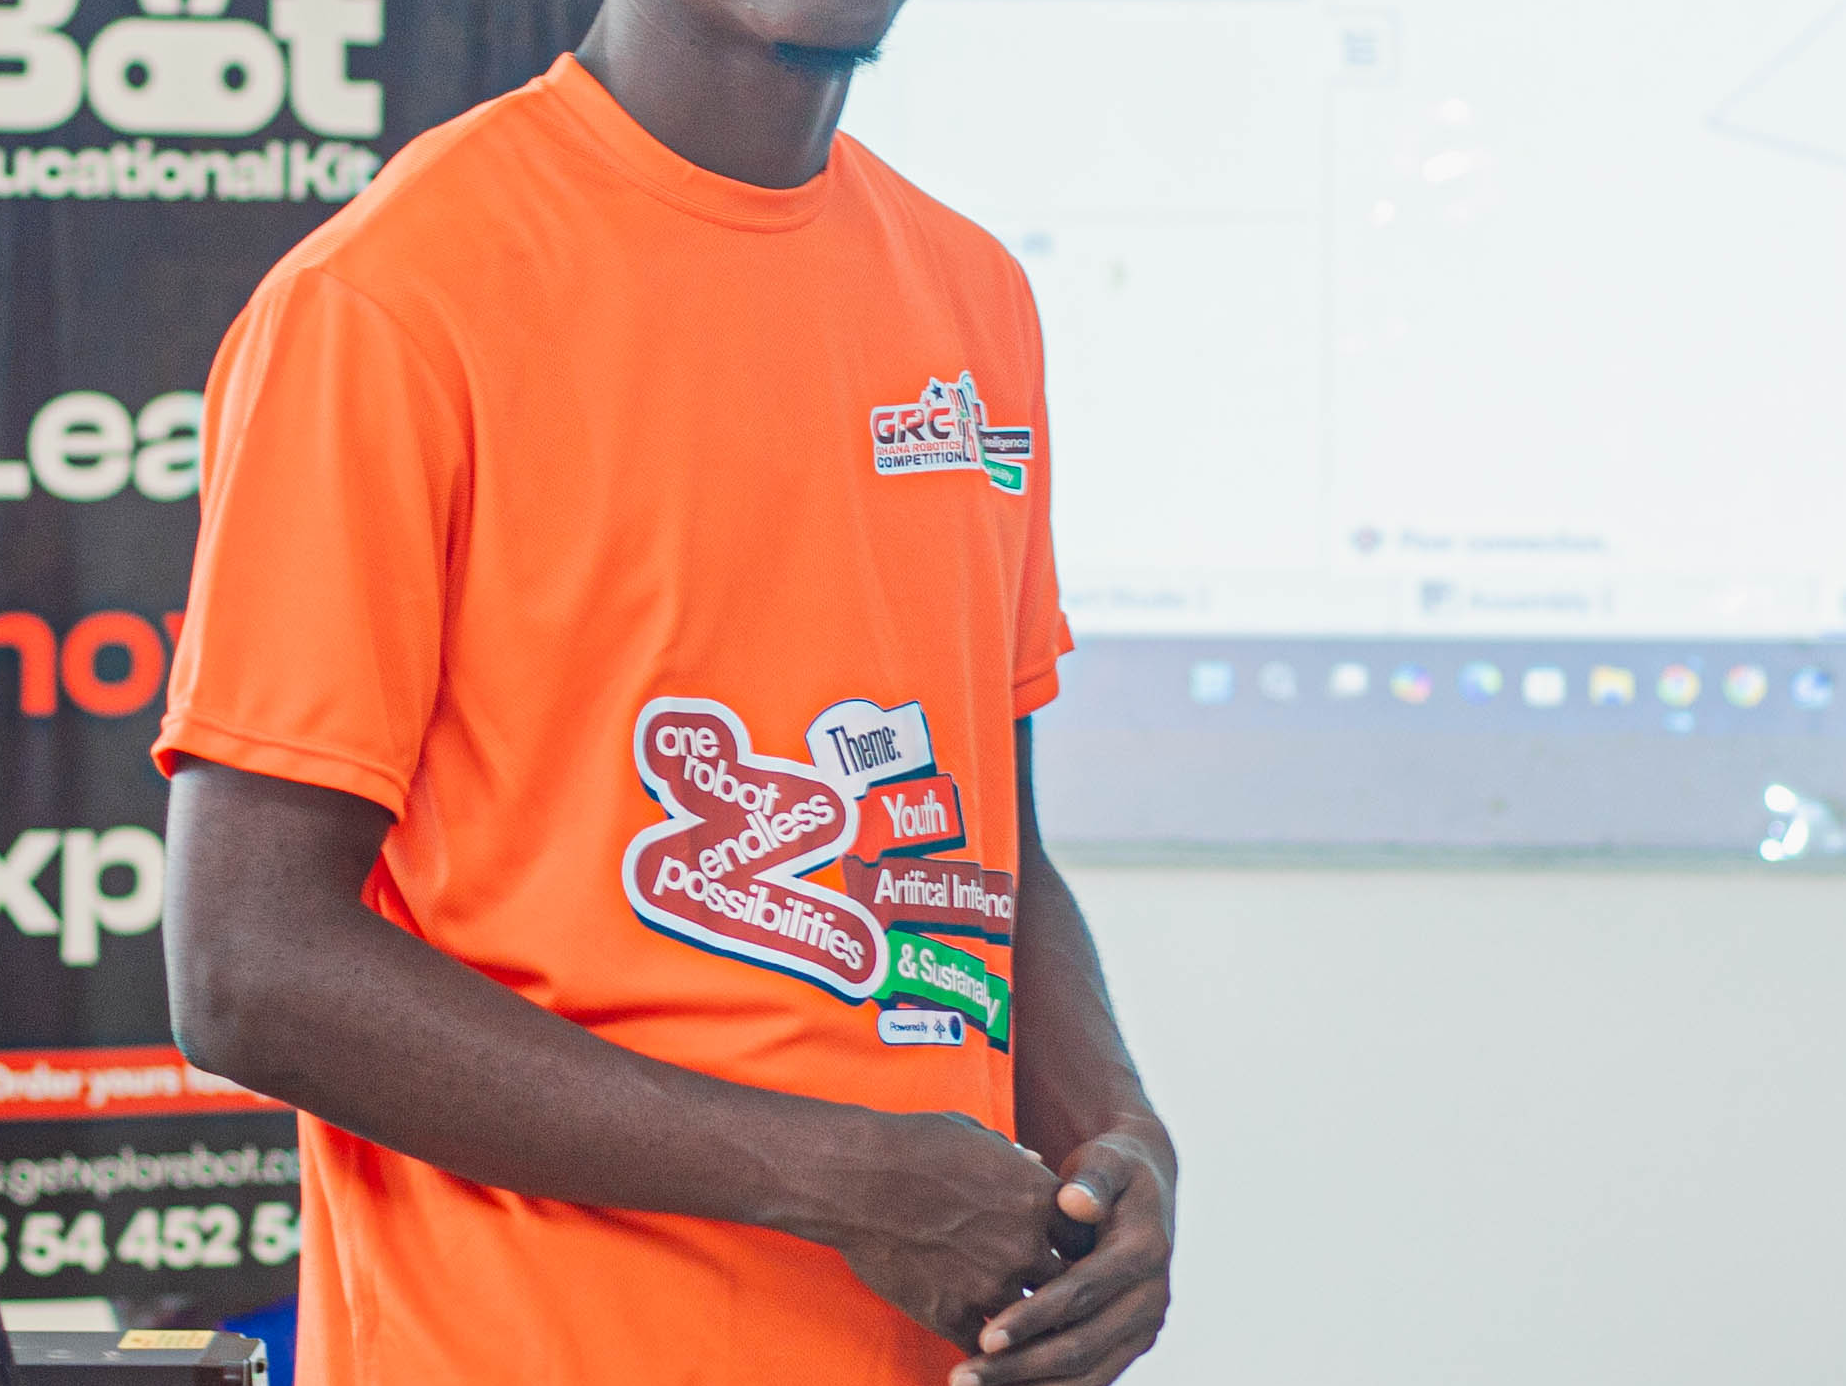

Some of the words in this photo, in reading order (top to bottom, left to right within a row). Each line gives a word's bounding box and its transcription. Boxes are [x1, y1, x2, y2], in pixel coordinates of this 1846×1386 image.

[875, 443, 911, 456] GHANA
[912, 440, 963, 455] ROBOTICS
[877, 451, 964, 469] COMPETITION
[655, 724, 721, 759] one
[826, 724, 902, 776] Theme:
[682, 753, 780, 816] robot
[698, 793, 835, 880] endless
[881, 788, 948, 839] Youth
[652, 854, 866, 972] possibilities
[897, 943, 918, 979] &
[86, 1063, 180, 1109] yours
[17, 1210, 109, 1276] 54
[116, 1203, 242, 1272] 452
